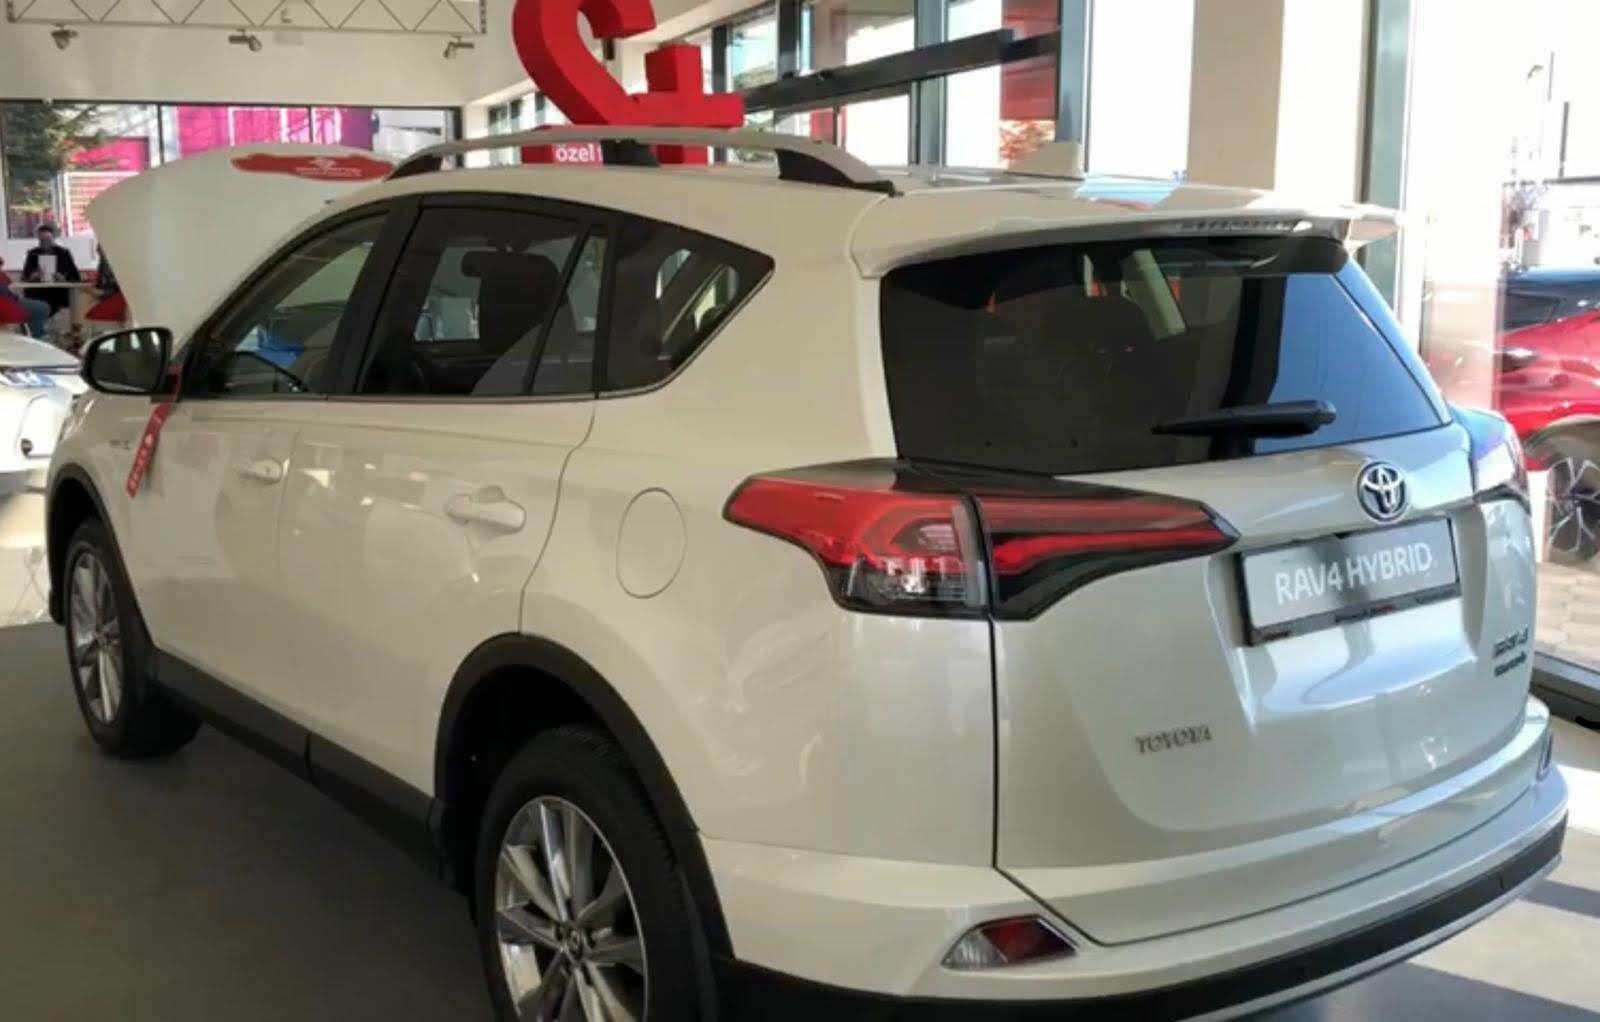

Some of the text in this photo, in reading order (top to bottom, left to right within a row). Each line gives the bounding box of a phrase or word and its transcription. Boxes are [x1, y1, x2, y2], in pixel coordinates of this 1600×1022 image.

[555, 143, 594, 162] özel
[1275, 542, 1433, 605] RAV4 HYBRID
[1135, 724, 1213, 754] TOYOTA
